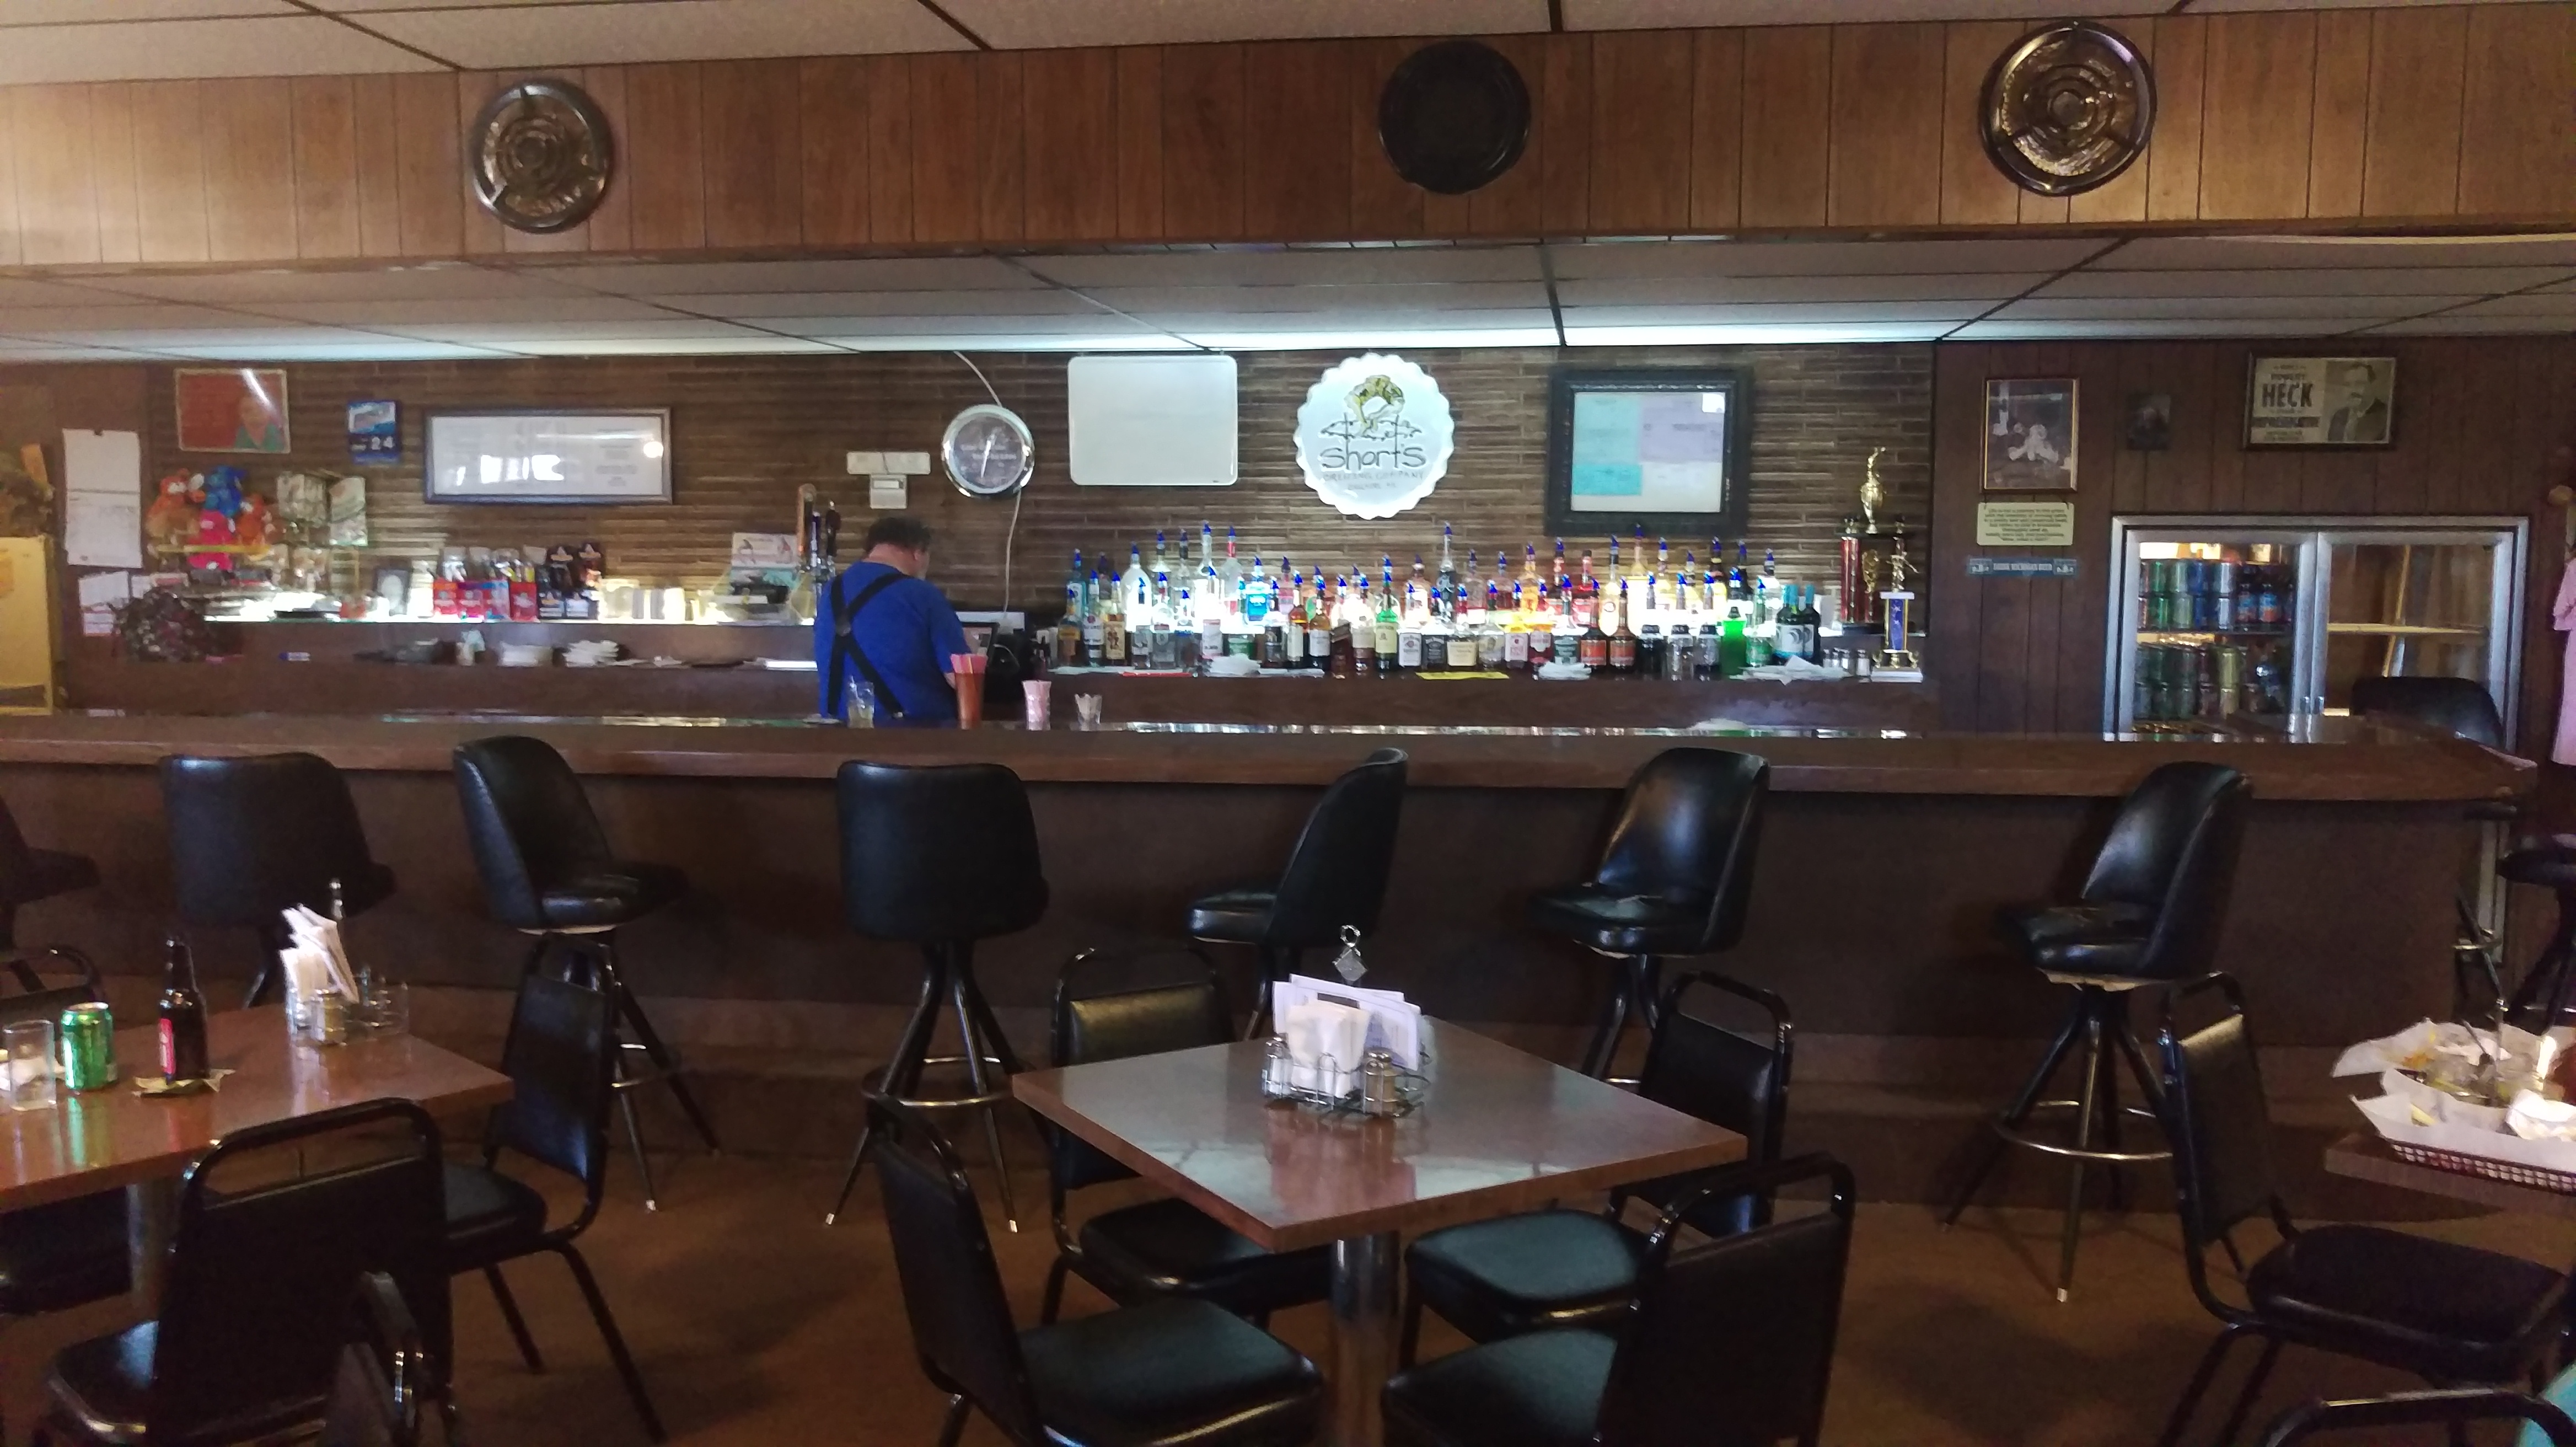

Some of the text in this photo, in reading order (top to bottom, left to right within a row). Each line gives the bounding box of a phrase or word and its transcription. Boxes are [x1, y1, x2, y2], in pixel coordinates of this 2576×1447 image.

[2262, 382, 2314, 408] HECK
[371, 436, 394, 450] 24
[1319, 412, 1427, 471] Short's
